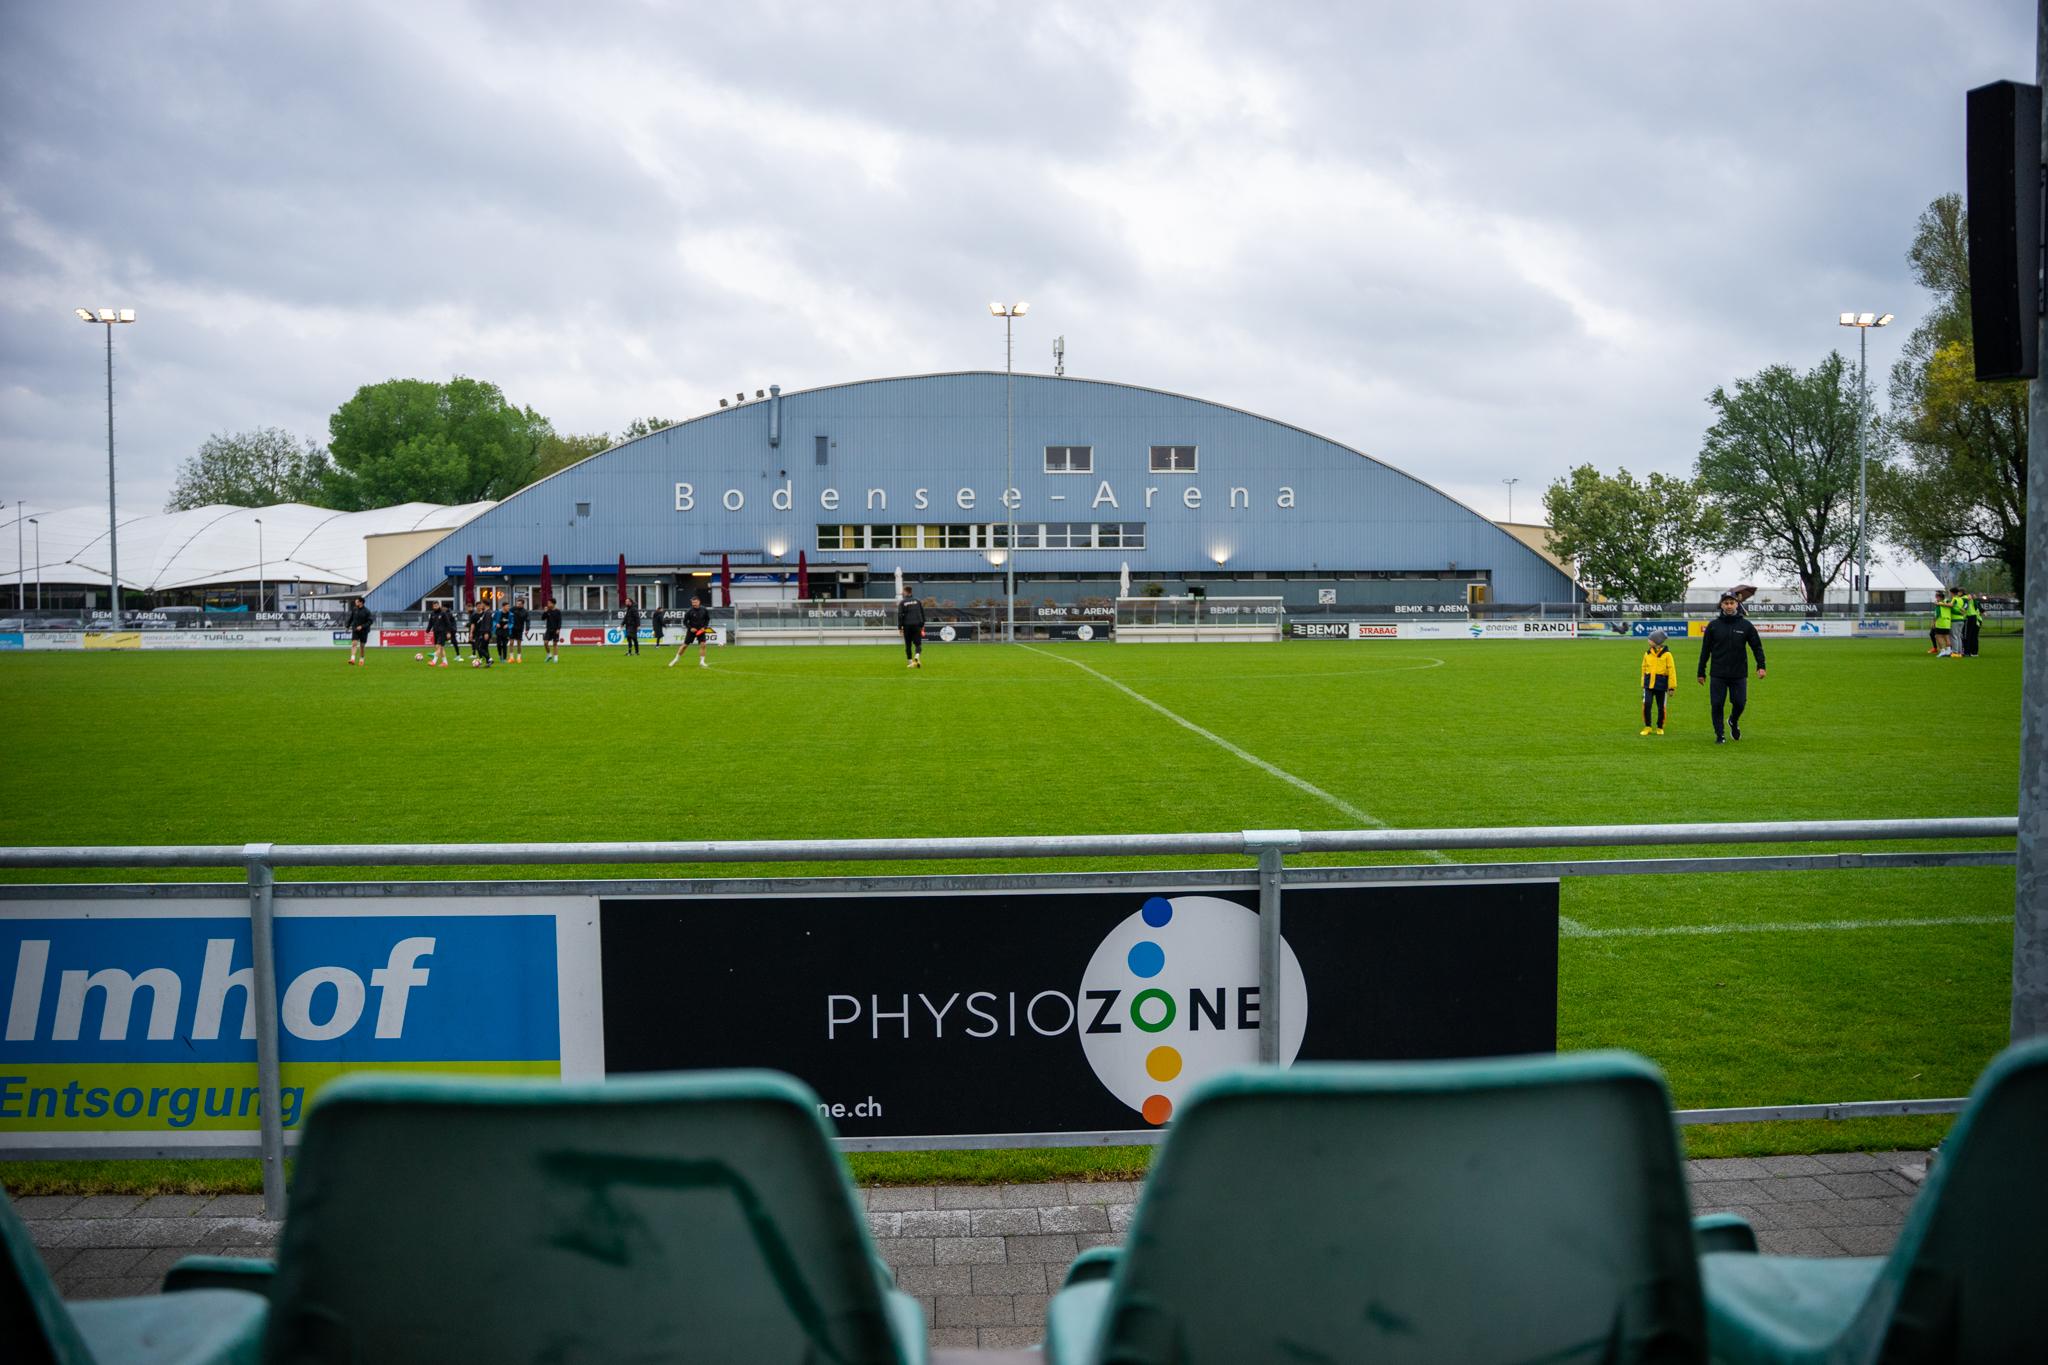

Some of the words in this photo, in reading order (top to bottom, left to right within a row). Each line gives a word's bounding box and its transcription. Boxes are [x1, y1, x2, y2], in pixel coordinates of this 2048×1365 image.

[674, 480, 1296, 512] Bodensee-Arena
[1038, 607, 1067, 616] BEMIX
[1083, 607, 1115, 615] ARENA
[1210, 606, 1239, 614] BEMIX
[1255, 606, 1286, 614] ARENA
[1394, 605, 1423, 613] BEMIX
[1438, 605, 1470, 613] ARENA
[1591, 604, 1618, 612] BEMIX
[1633, 604, 1663, 612] ARENA
[1748, 604, 1775, 612] BEMIX
[1789, 604, 1818, 612] ARENA
[92, 611, 112, 619] BEM
[135, 612, 168, 620] ARENA
[256, 612, 284, 620] BEMIX
[299, 612, 331, 620] ARENA
[808, 609, 838, 618] BEMIX
[854, 609, 887, 618] ARENA
[1307, 624, 1347, 635] BEMIX
[1359, 627, 1397, 635] STRABAG
[5, 936, 437, 1041] Imhof
[0, 1075, 305, 1128] Entsorgung
[816, 1096, 882, 1118] ne.ch
